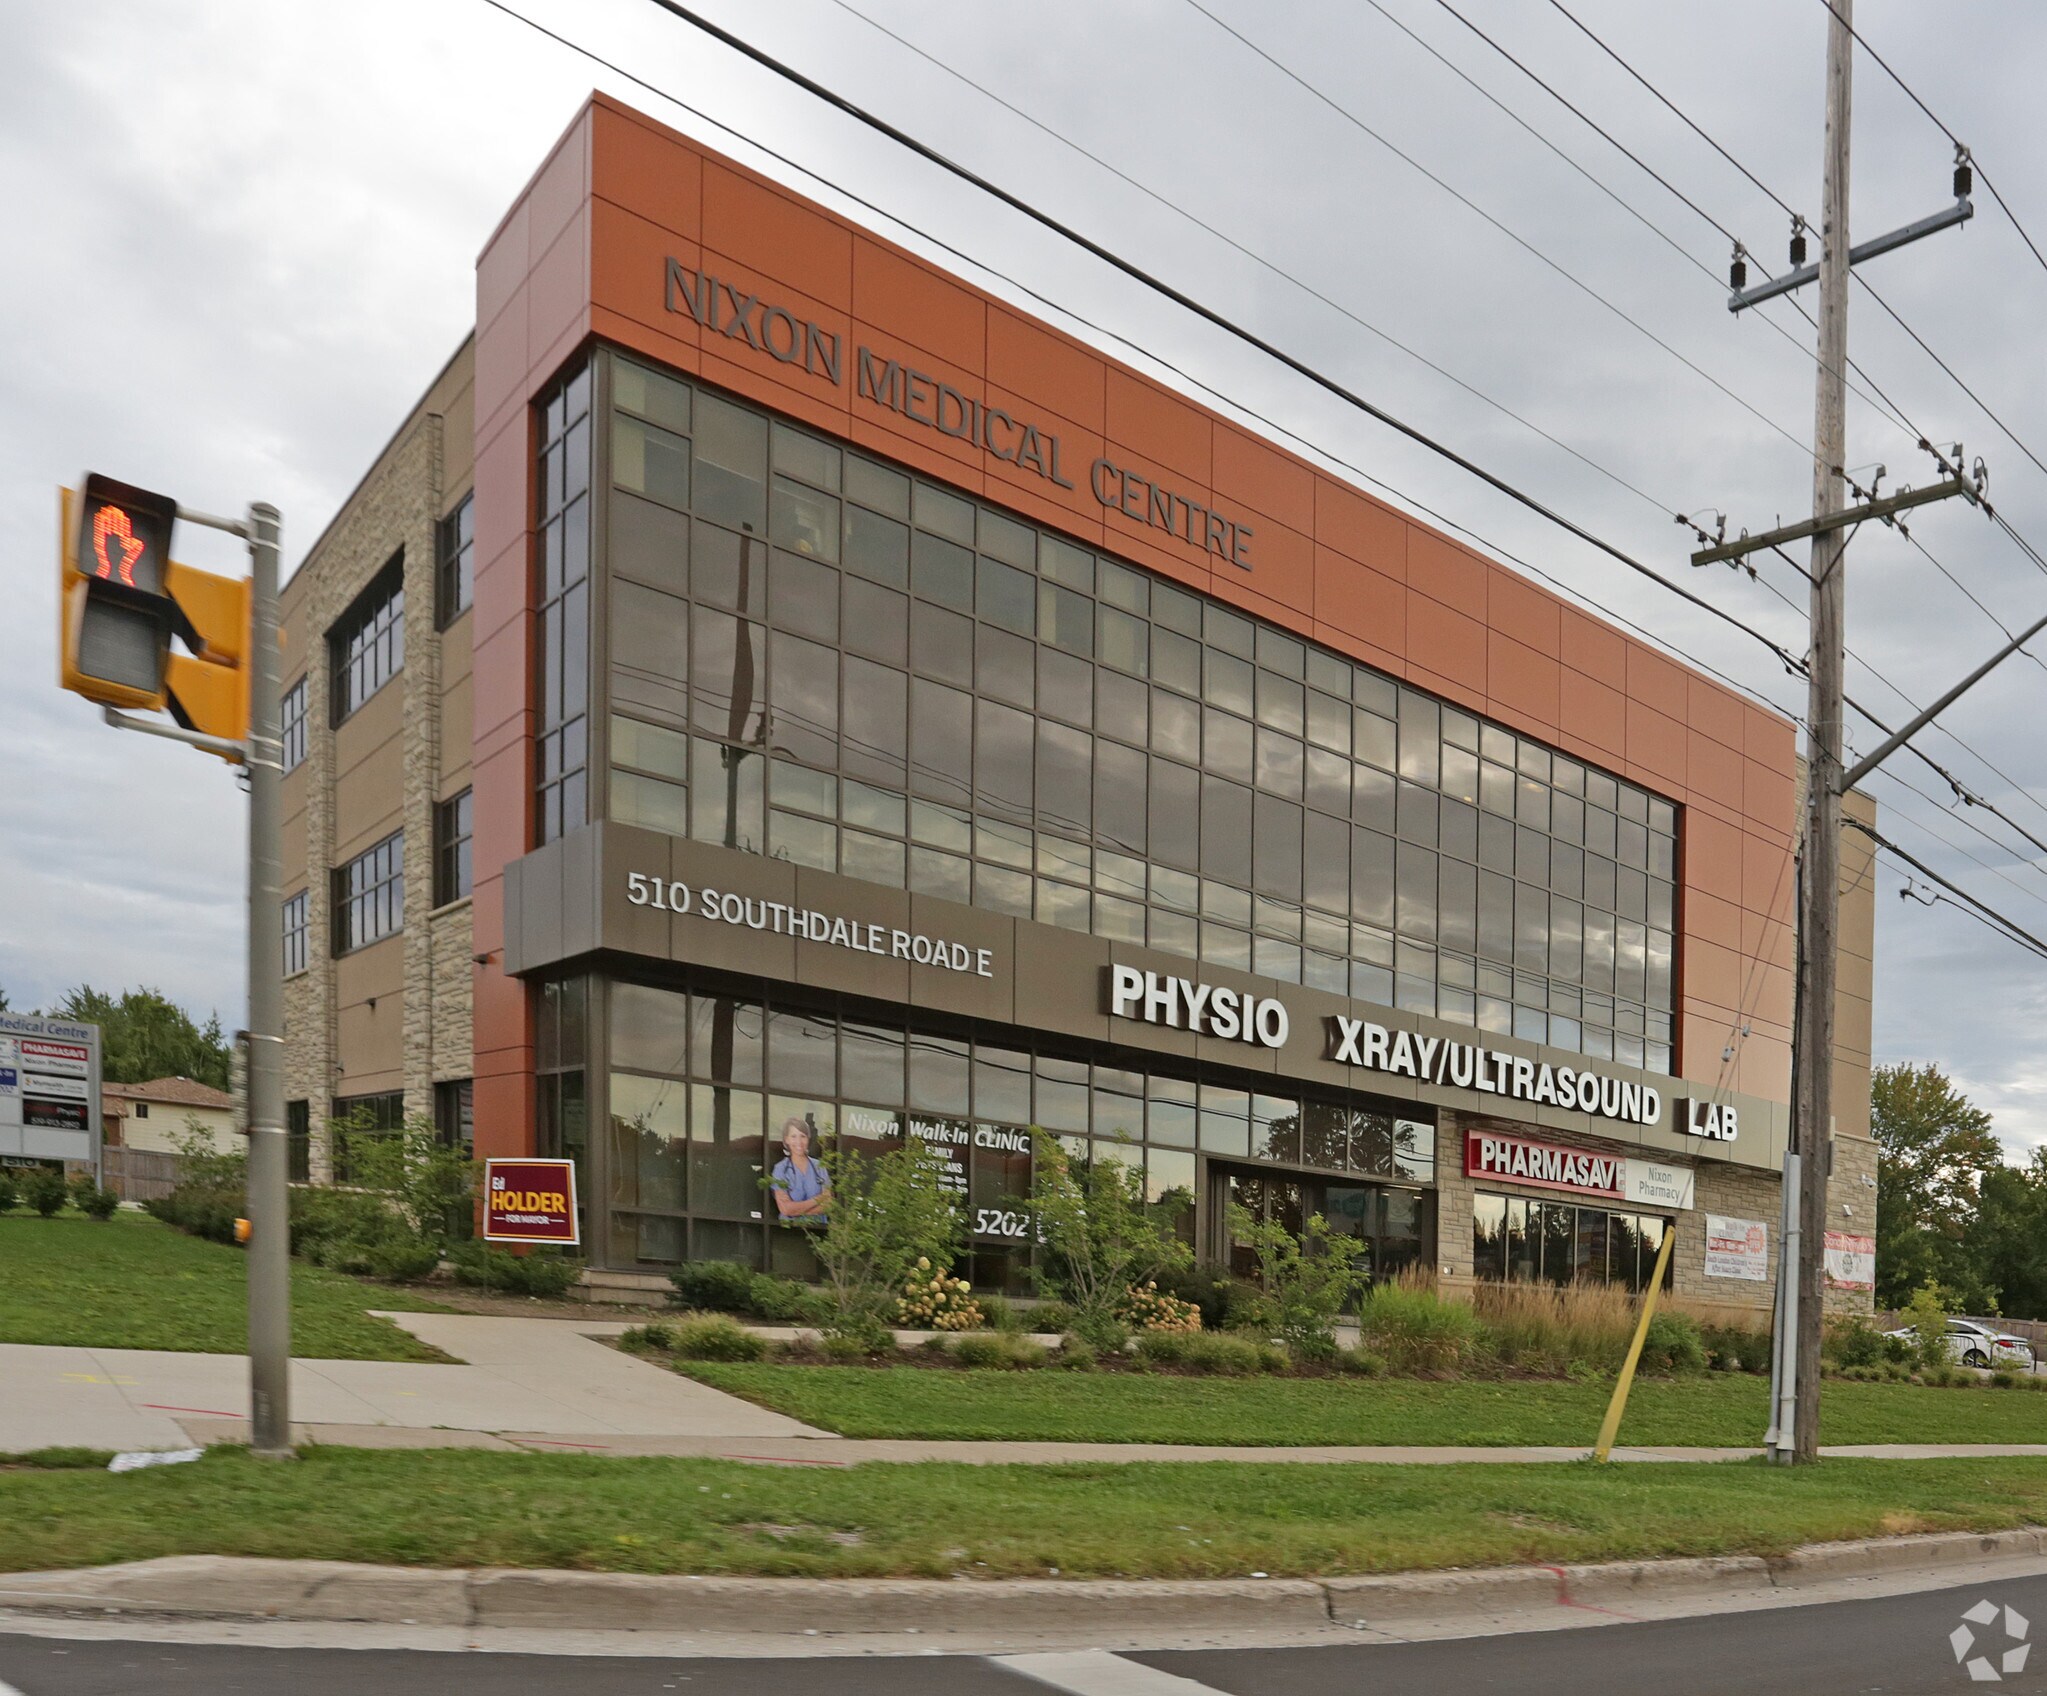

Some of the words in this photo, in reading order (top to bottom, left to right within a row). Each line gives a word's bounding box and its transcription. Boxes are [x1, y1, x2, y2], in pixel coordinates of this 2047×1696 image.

[665, 255, 841, 387] NIXON
[857, 344, 1075, 491] MEDICAL
[1090, 456, 1253, 572] CENTRE
[627, 871, 691, 914] 510
[700, 888, 885, 956] SOUTHDALE
[892, 929, 970, 972] ROAD
[977, 948, 993, 978] E
[47, 1023, 88, 1040] Centre
[22, 1043, 86, 1059] PHARMASAVE
[1112, 963, 1289, 1048] PHYSIO
[1334, 1015, 1661, 1126] XRAY/ULTRASOUND
[1688, 1097, 1738, 1141] LAB
[848, 1113, 899, 1137] Nixon
[910, 1120, 969, 1145] Walk-In
[974, 1130, 1031, 1155] CLINIC
[1481, 1138, 1626, 1192] PHARMASAVE
[1648, 1167, 1672, 1184] Nixon
[491, 1191, 567, 1213] HOLDER
[1638, 1180, 1681, 1201] Pharmacy
